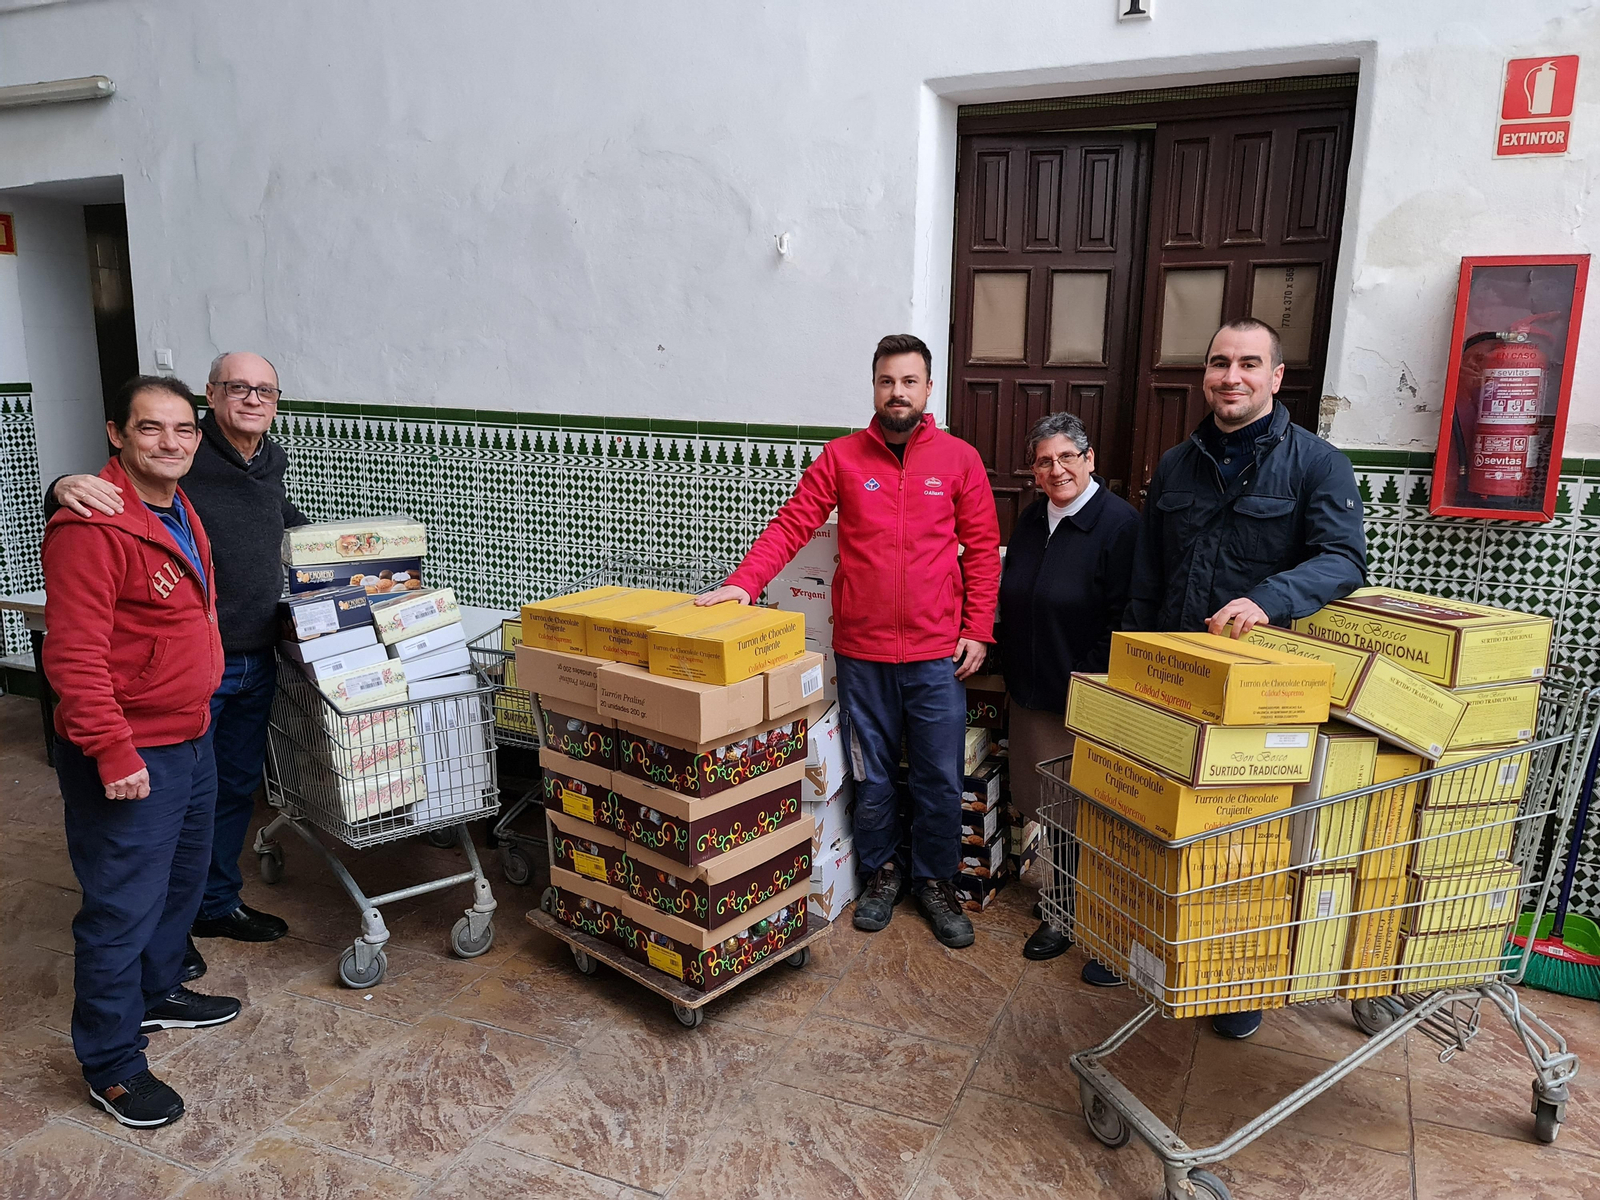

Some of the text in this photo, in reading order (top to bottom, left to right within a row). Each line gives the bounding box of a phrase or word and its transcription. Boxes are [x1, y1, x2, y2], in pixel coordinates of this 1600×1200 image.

[1501, 130, 1565, 147] EXTINTOR
[1285, 267, 1295, 282] 565
[1283, 290, 1293, 306] 370
[1281, 313, 1291, 328] 770
[1511, 352, 1537, 360] CASO
[1484, 457, 1522, 465] sevitas
[811, 529, 831, 540] gani
[790, 586, 826, 601] Vergani
[554, 616, 579, 627] Chocolate
[1329, 614, 1407, 642] Don Bosco
[621, 627, 648, 640] Chocolate
[759, 634, 768, 643] de
[768, 622, 796, 640] Chocolate
[754, 640, 781, 657] Crujiente
[1248, 633, 1276, 649] Don
[1308, 623, 1430, 665] SURTIDO TRADICIONAL
[676, 646, 699, 656] Chocolate
[1155, 651, 1166, 664] de
[1168, 655, 1210, 678] Chocolate
[1147, 664, 1184, 686] Crujiente
[1271, 679, 1300, 687] Chocolate
[1301, 679, 1327, 689] Crujiente
[623, 693, 646, 706] Praliné
[1134, 682, 1192, 710] Calidad Suprema
[607, 703, 630, 714] unidades
[630, 708, 640, 716] 200
[1230, 751, 1288, 762] Don Bosco
[1209, 764, 1303, 776] SURTIDO TRADICIONAL
[1105, 772, 1139, 798] Crujiente
[1113, 761, 1123, 775] de
[1124, 766, 1164, 795] Chocolate
[1094, 787, 1146, 824] Calidad Suprema
[1225, 793, 1236, 804] de
[1237, 793, 1279, 804] Chocolate
[1216, 805, 1253, 818] Crujiente
